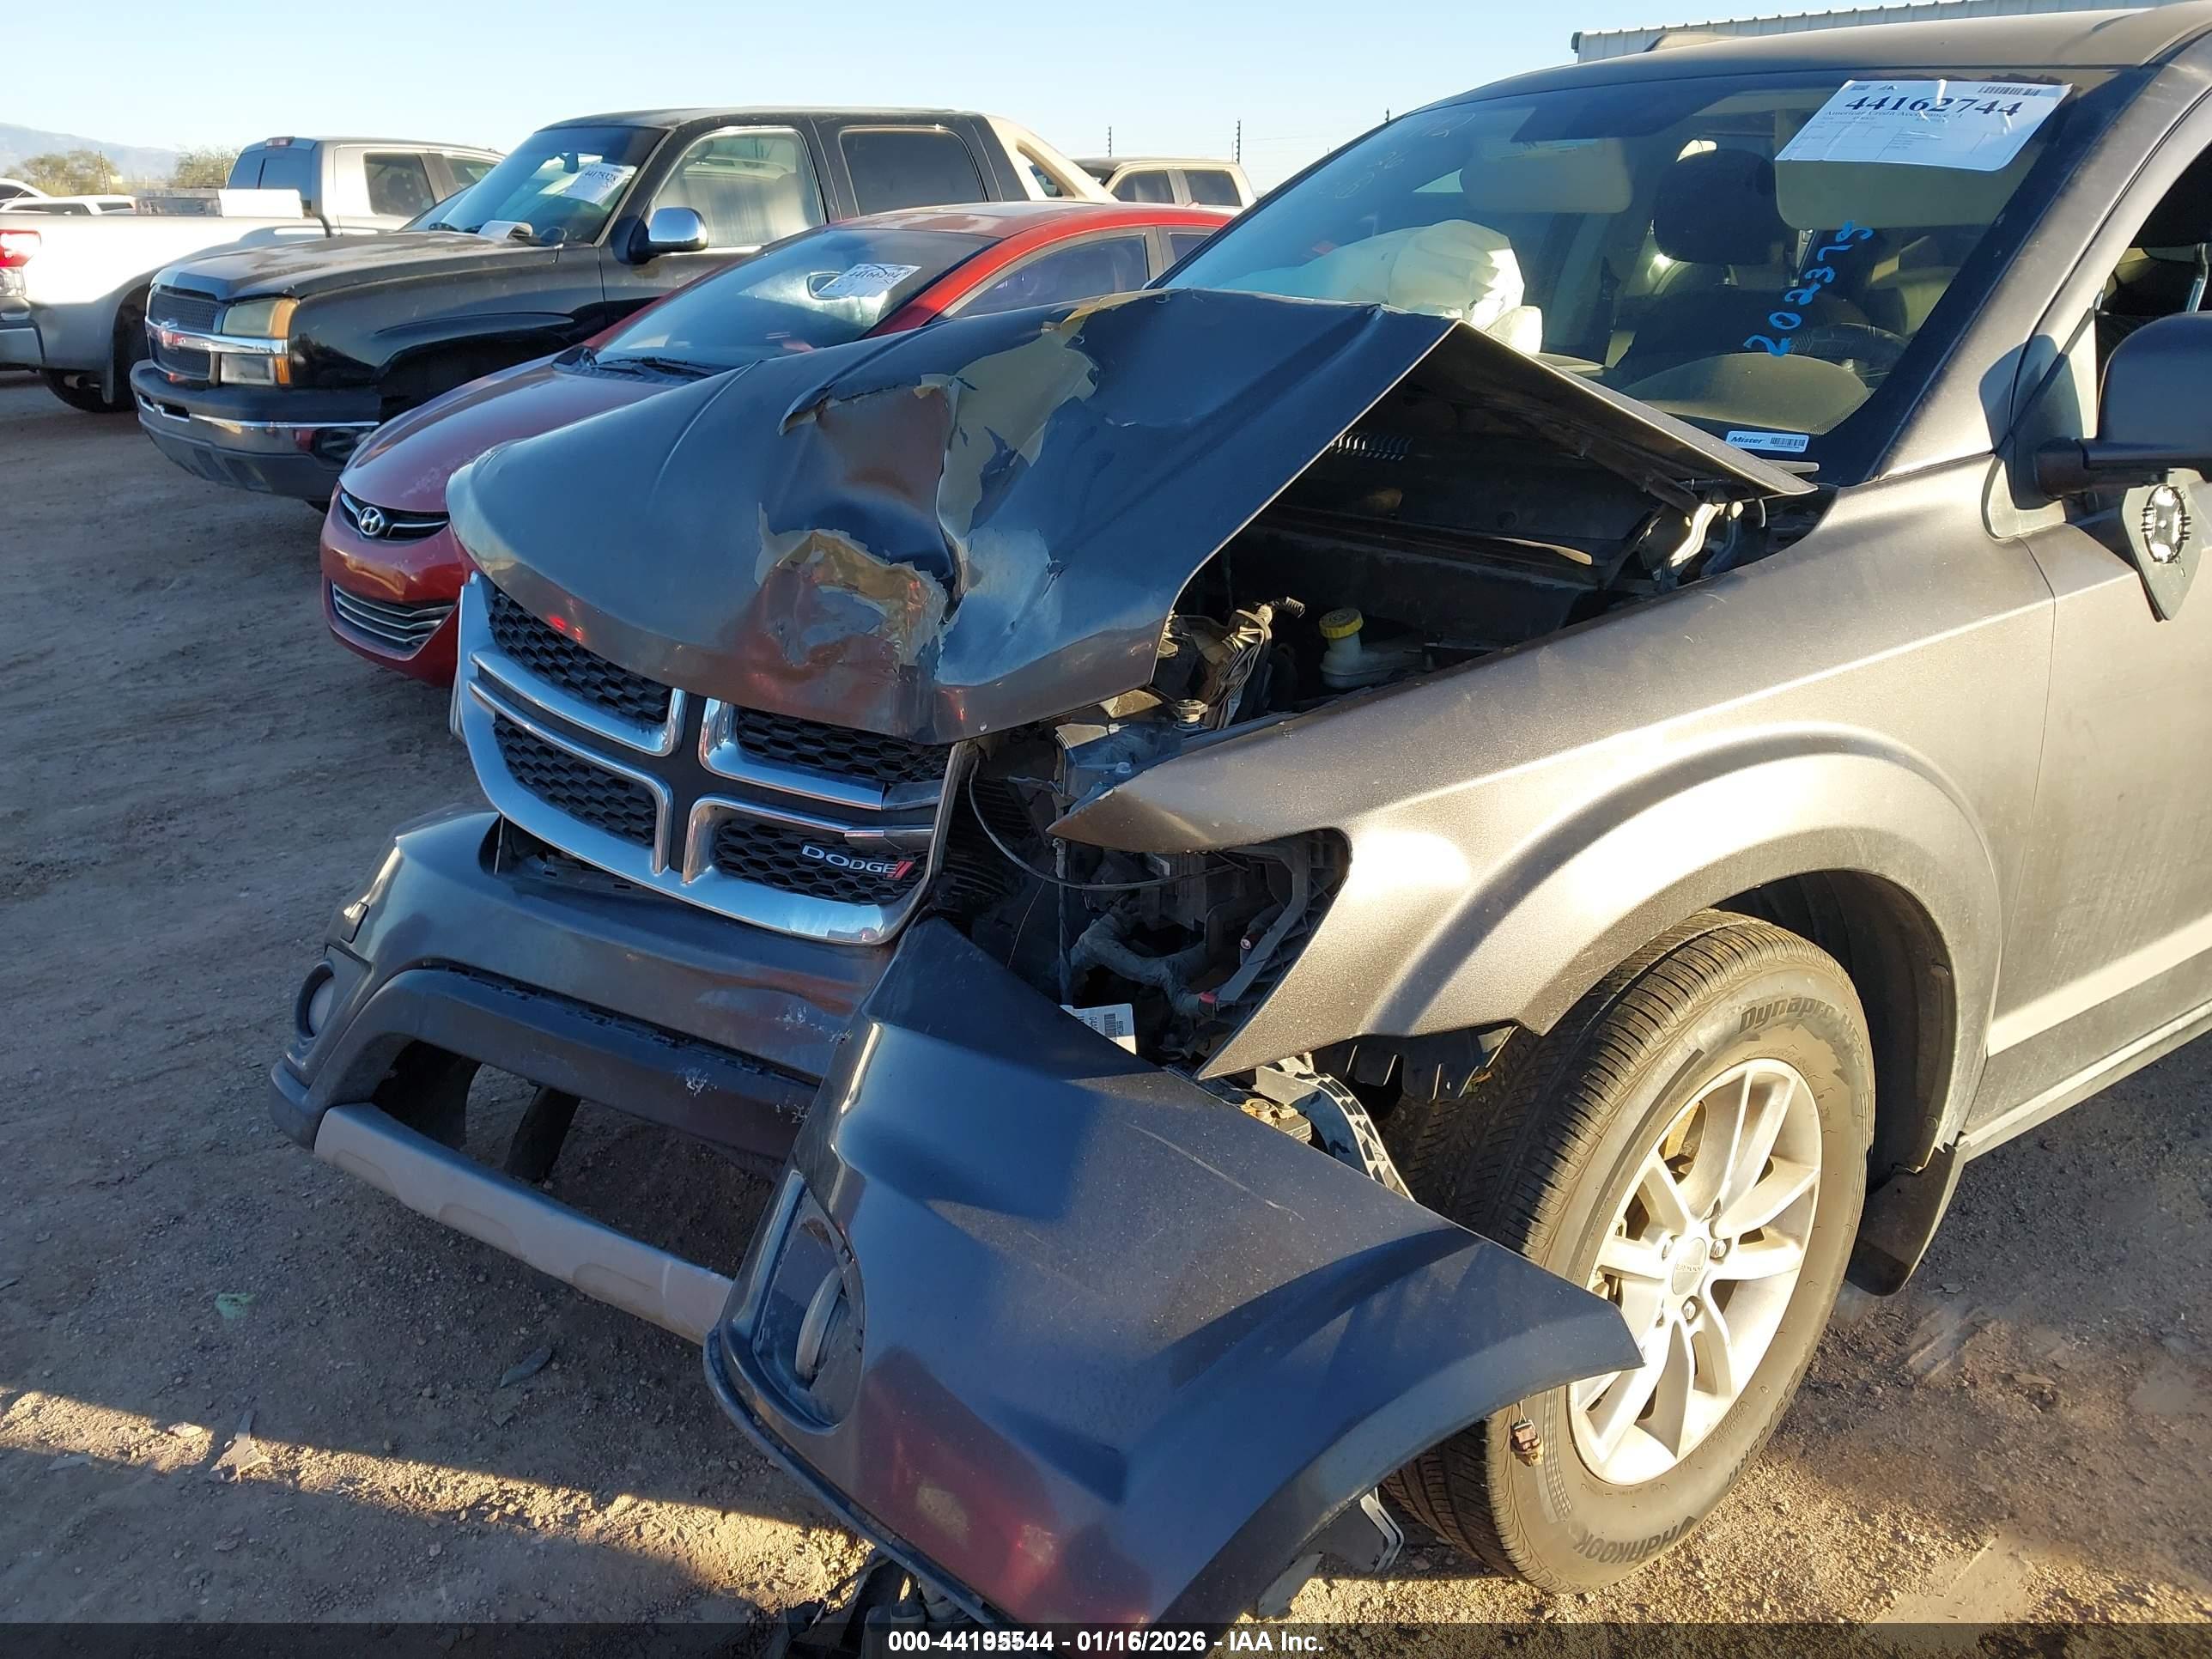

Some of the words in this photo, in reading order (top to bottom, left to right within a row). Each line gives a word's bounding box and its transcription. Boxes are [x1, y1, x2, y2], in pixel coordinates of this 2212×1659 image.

[1844, 95, 2023, 117] 44162744
[1731, 436, 1766, 445] Mister
[802, 844, 898, 874] DODGE
[1738, 996, 1836, 1034] Dynapro
